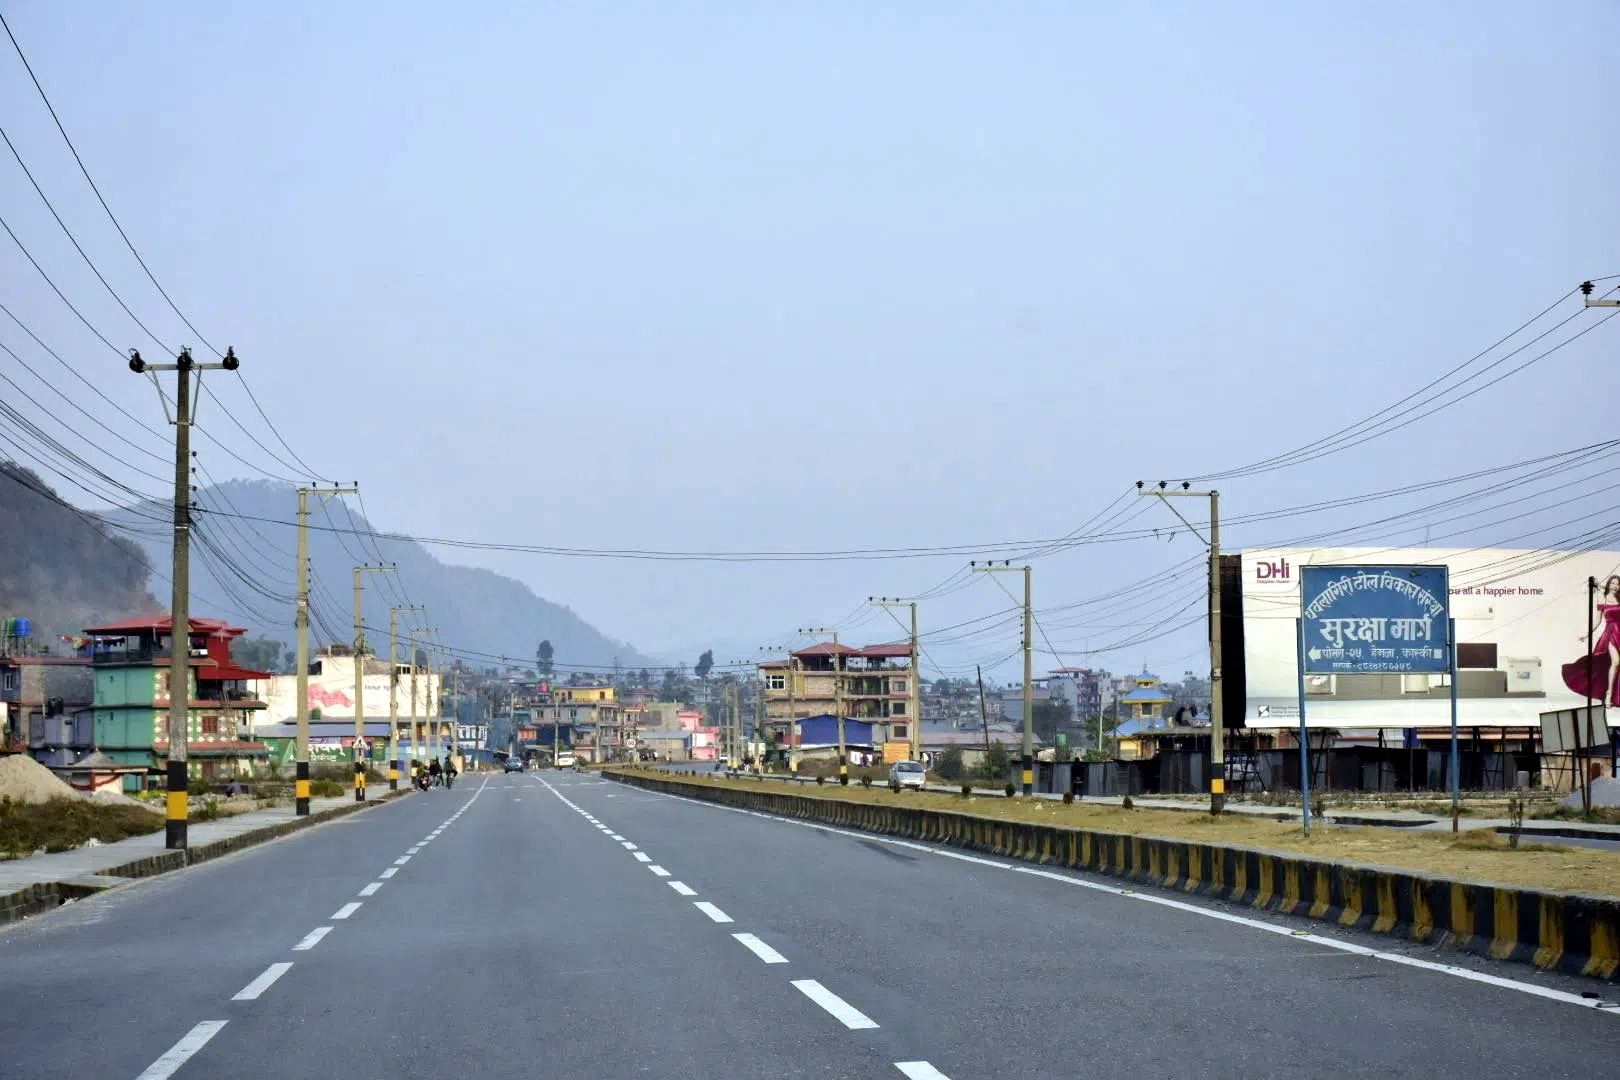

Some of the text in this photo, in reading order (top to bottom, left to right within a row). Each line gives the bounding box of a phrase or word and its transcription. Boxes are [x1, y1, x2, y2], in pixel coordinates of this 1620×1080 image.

[1353, 571, 1379, 592] टोल
[1380, 571, 1421, 600] विकास
[1417, 589, 1444, 617] संस्था
[1484, 586, 1516, 597] happier
[1519, 586, 1544, 595] home
[1319, 614, 1432, 648] सुरक्षा मार्ग
